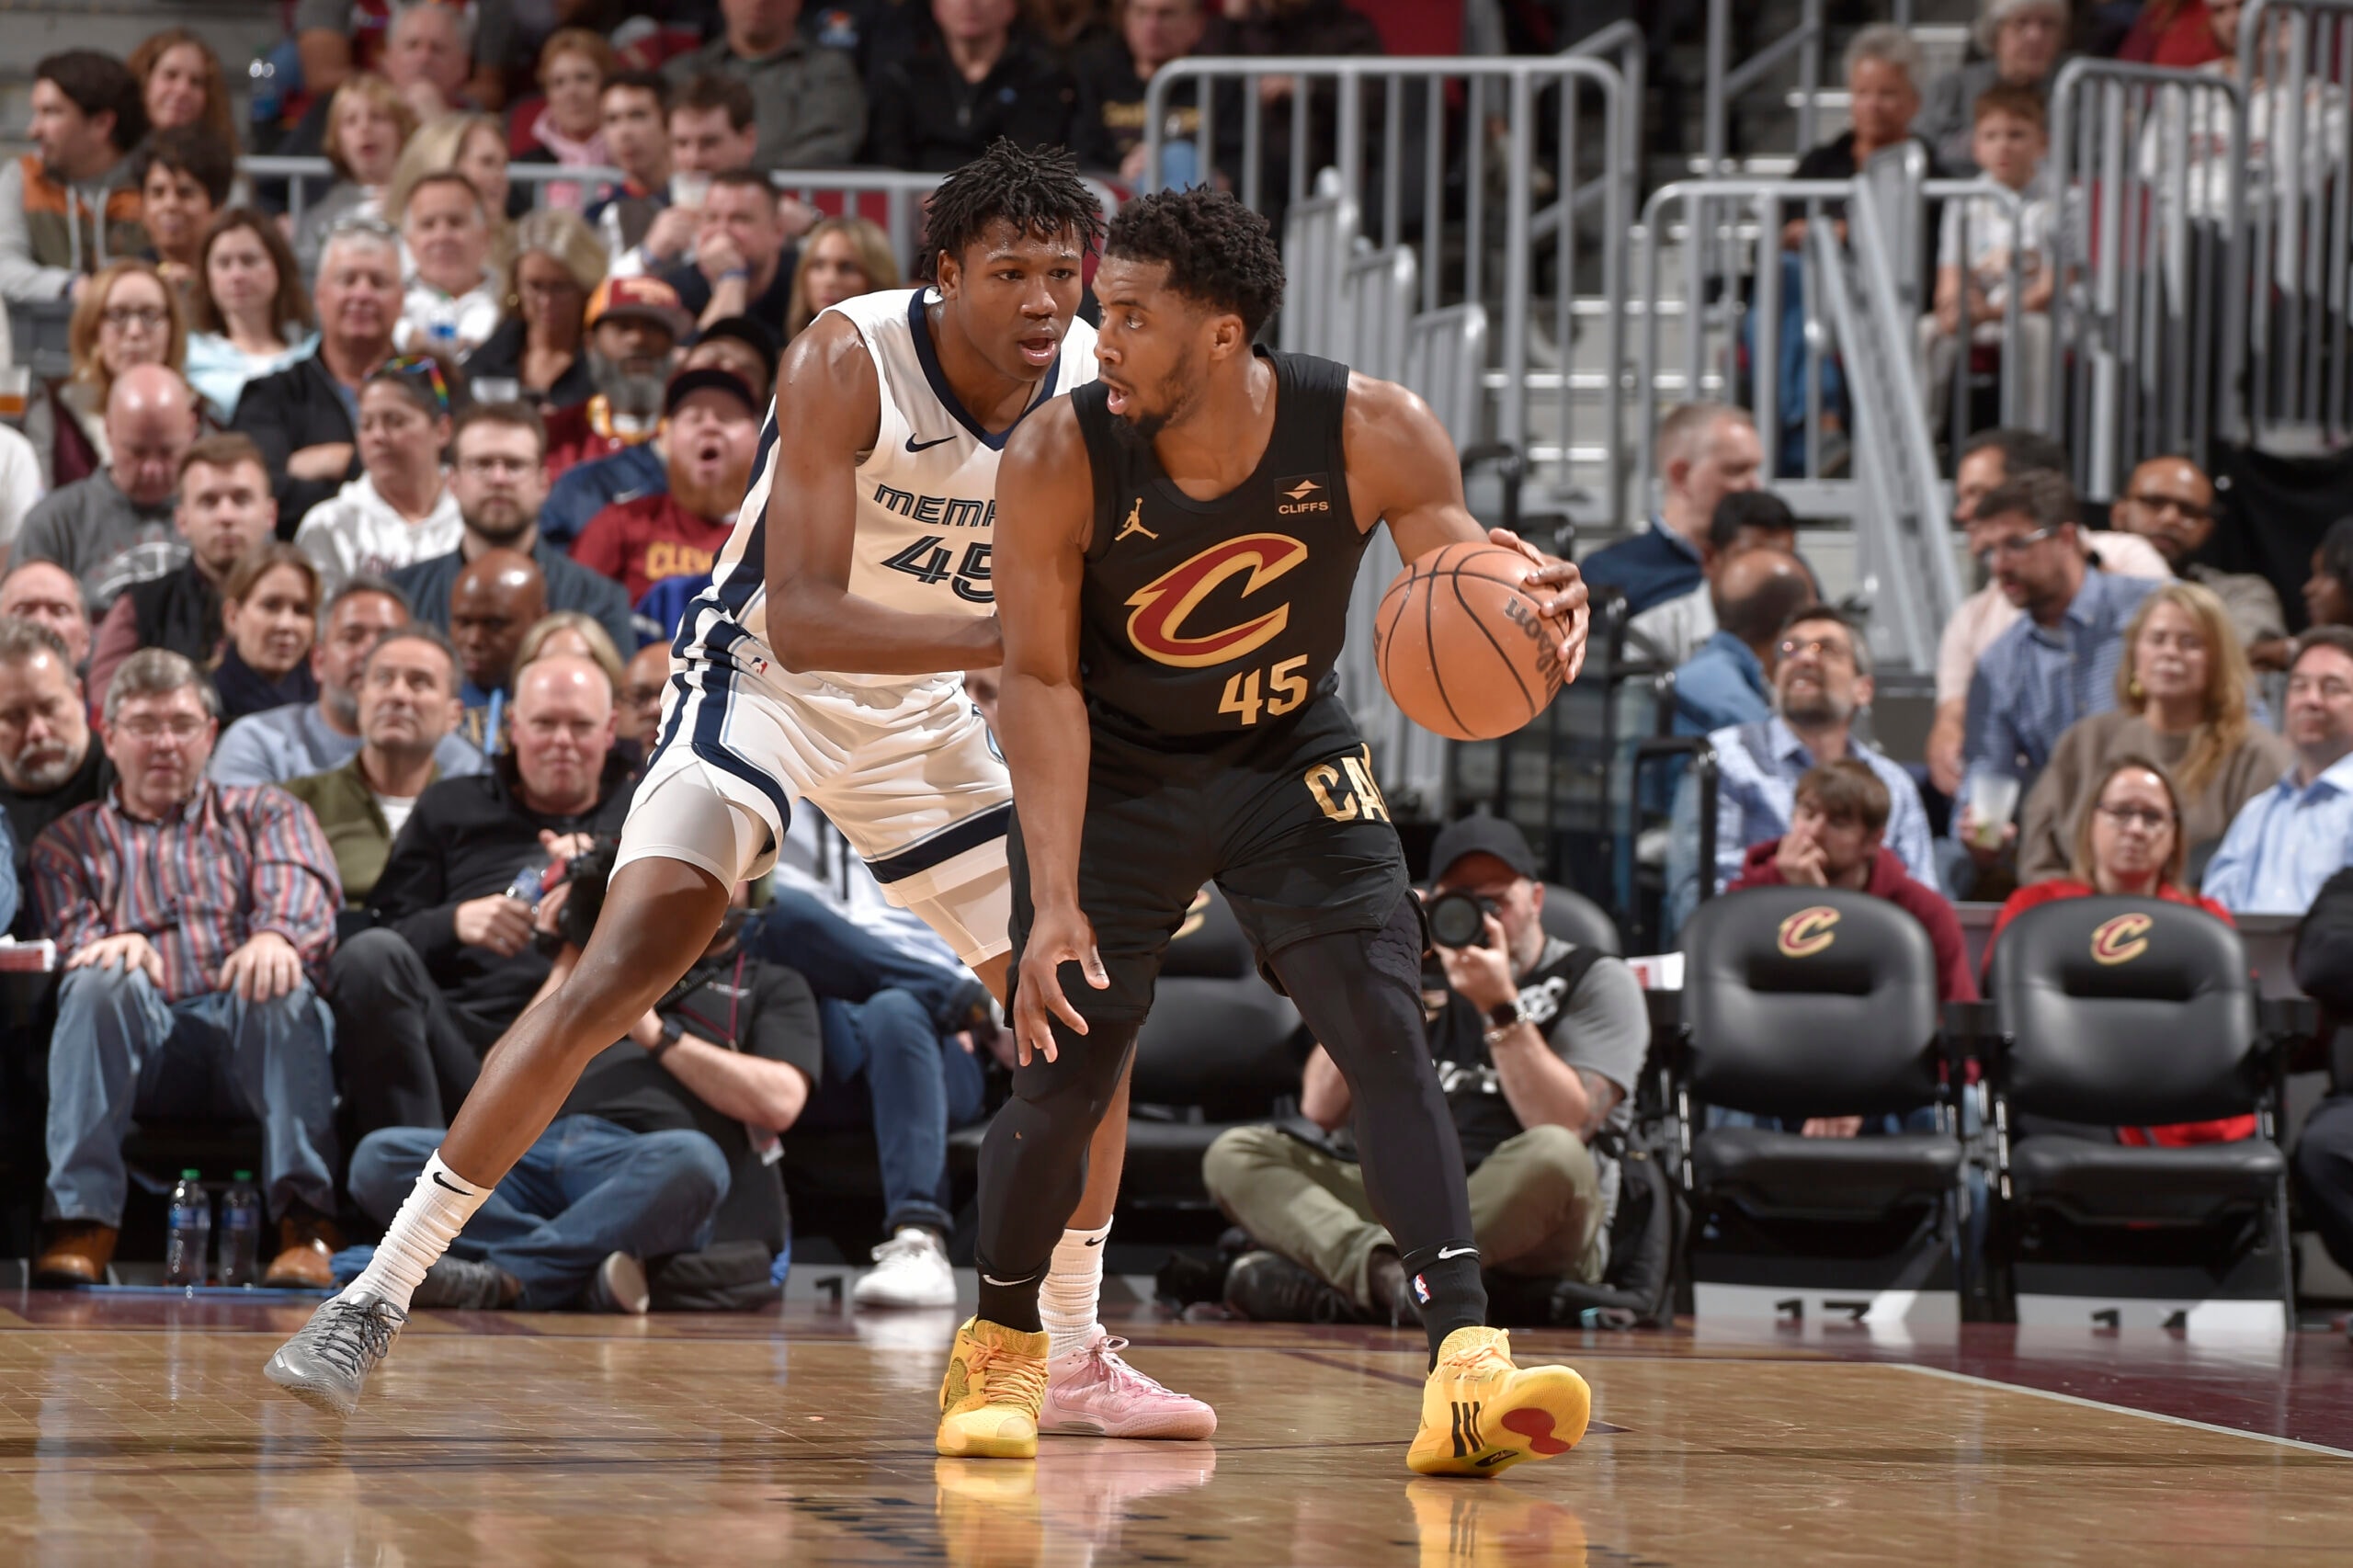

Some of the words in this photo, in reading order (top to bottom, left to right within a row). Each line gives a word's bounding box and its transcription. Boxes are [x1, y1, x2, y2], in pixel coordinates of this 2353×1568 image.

[1278, 501, 1329, 515] CLIFFS
[880, 535, 995, 604] 45
[1217, 653, 1309, 725] 45
